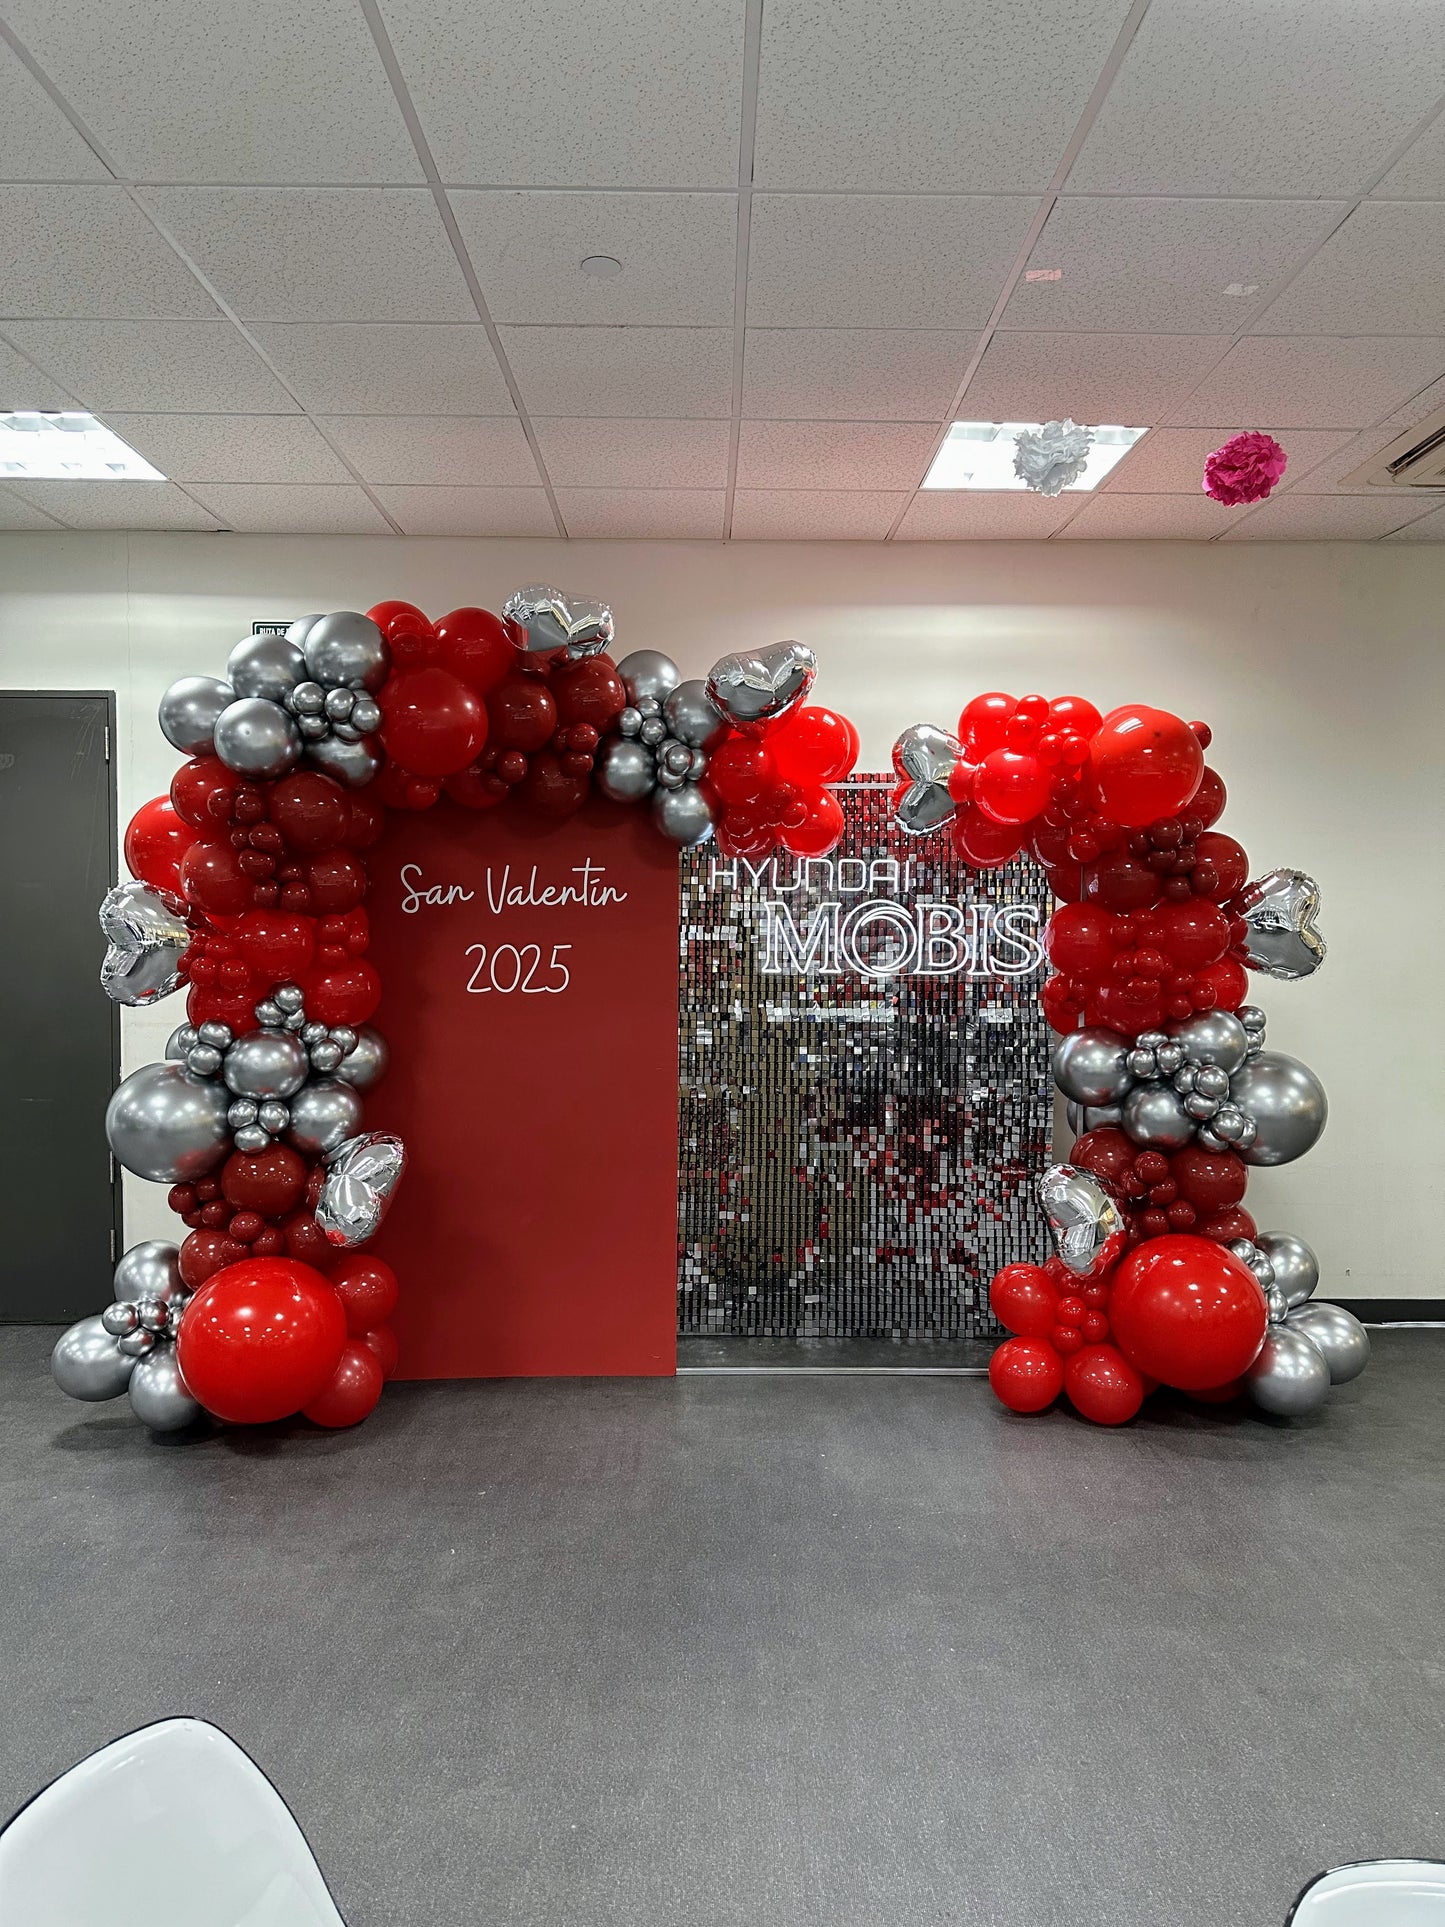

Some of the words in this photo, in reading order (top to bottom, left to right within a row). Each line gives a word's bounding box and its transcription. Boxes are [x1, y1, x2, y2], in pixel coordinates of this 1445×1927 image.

[400, 863, 475, 914] San
[486, 857, 628, 914] Valentín
[711, 857, 910, 893] HYUNDAI
[761, 899, 1044, 977] MOBIS
[464, 943, 573, 993] 2025
